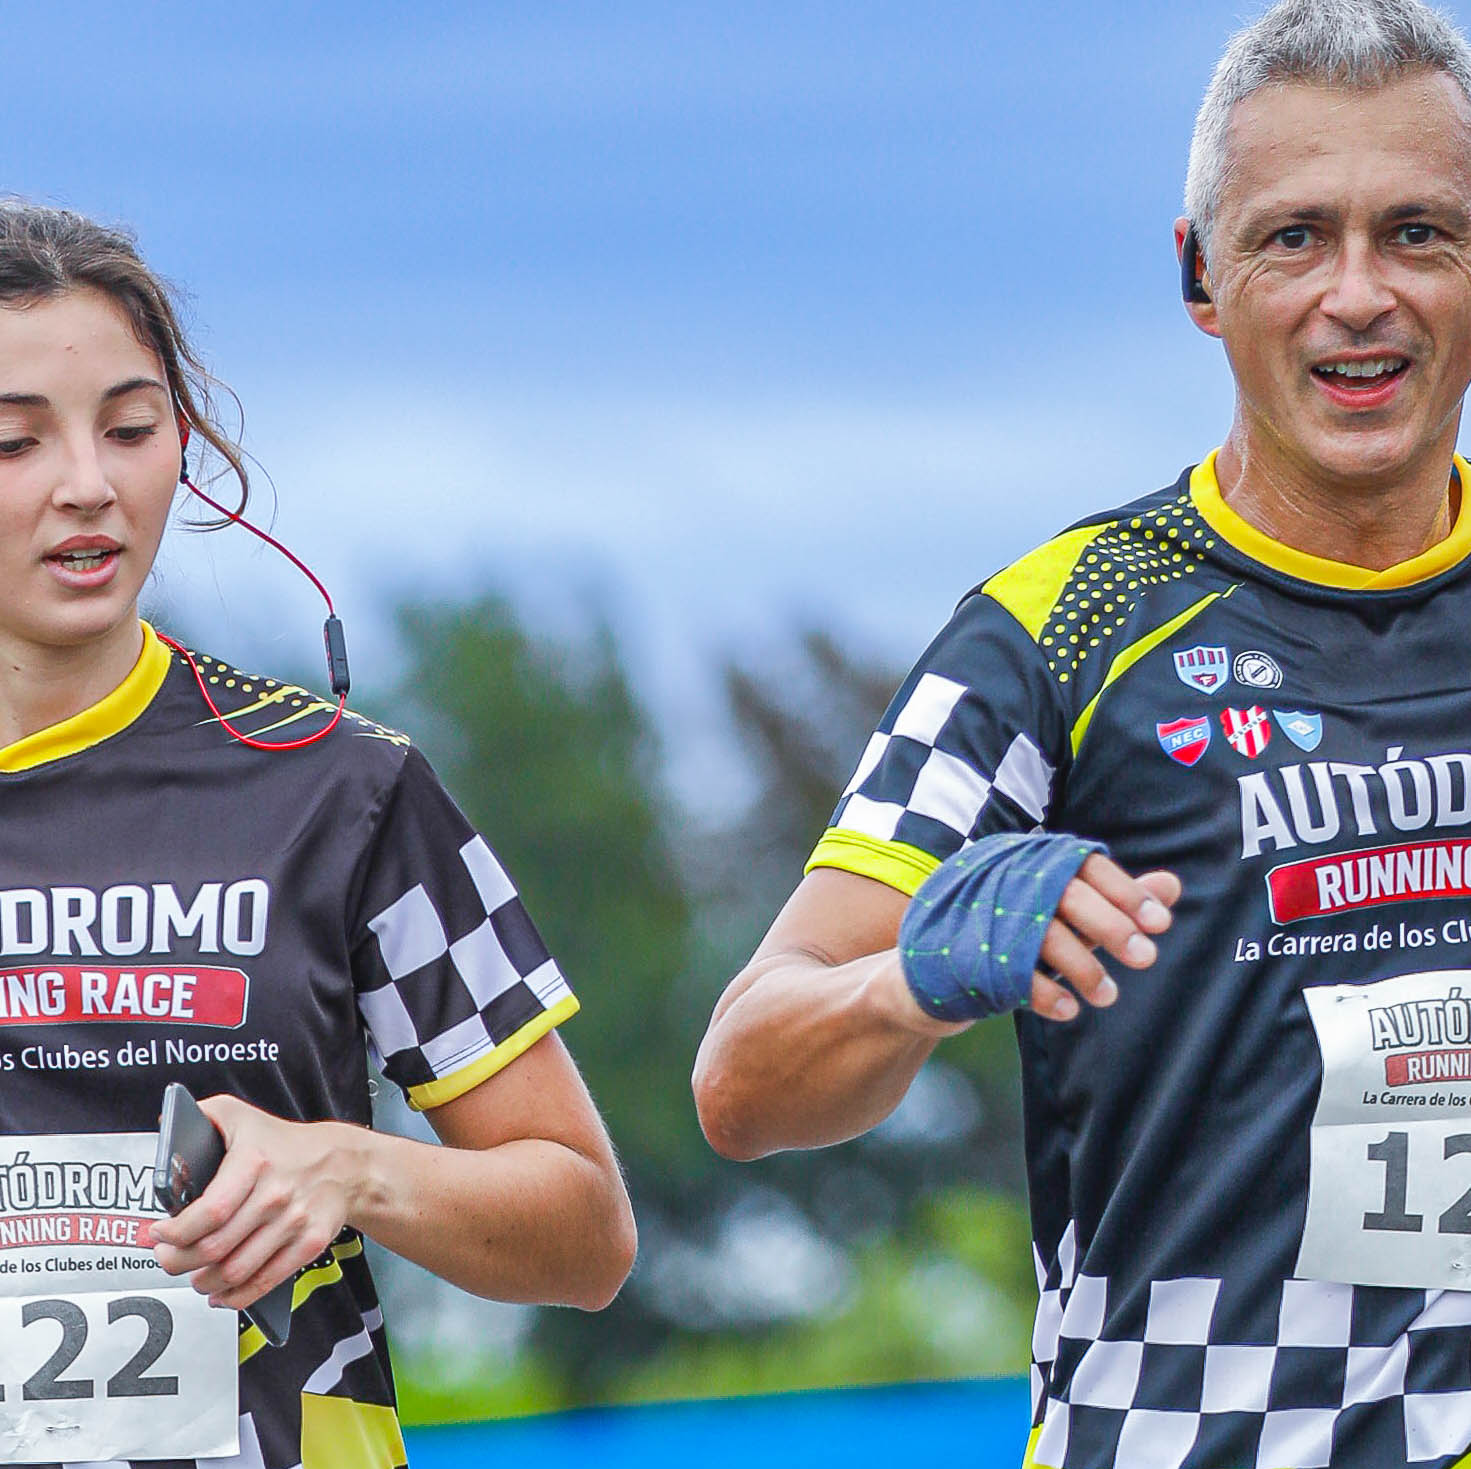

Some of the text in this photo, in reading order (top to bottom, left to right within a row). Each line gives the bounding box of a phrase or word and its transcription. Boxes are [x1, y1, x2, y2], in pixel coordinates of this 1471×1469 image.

[1171, 728, 1204, 748] NEC
[1234, 919, 1471, 962] La Carrera de los Cl
[79, 971, 197, 1018] RACE
[1368, 987, 1471, 1051] AUTÓ
[21, 1043, 110, 1070] Clubes
[116, 1040, 157, 1066] del
[166, 1038, 280, 1064] Noroeste
[1363, 1091, 1377, 1105] La
[1380, 1091, 1426, 1106] Carrera
[1429, 1092, 1446, 1106] de
[1448, 1092, 1467, 1107] los
[79, 1216, 139, 1245] RACE
[0, 1259, 18, 1274] de
[21, 1258, 42, 1273] los
[45, 1257, 93, 1272] Clubes
[96, 1256, 117, 1271] del
[121, 1256, 163, 1270] Noro
